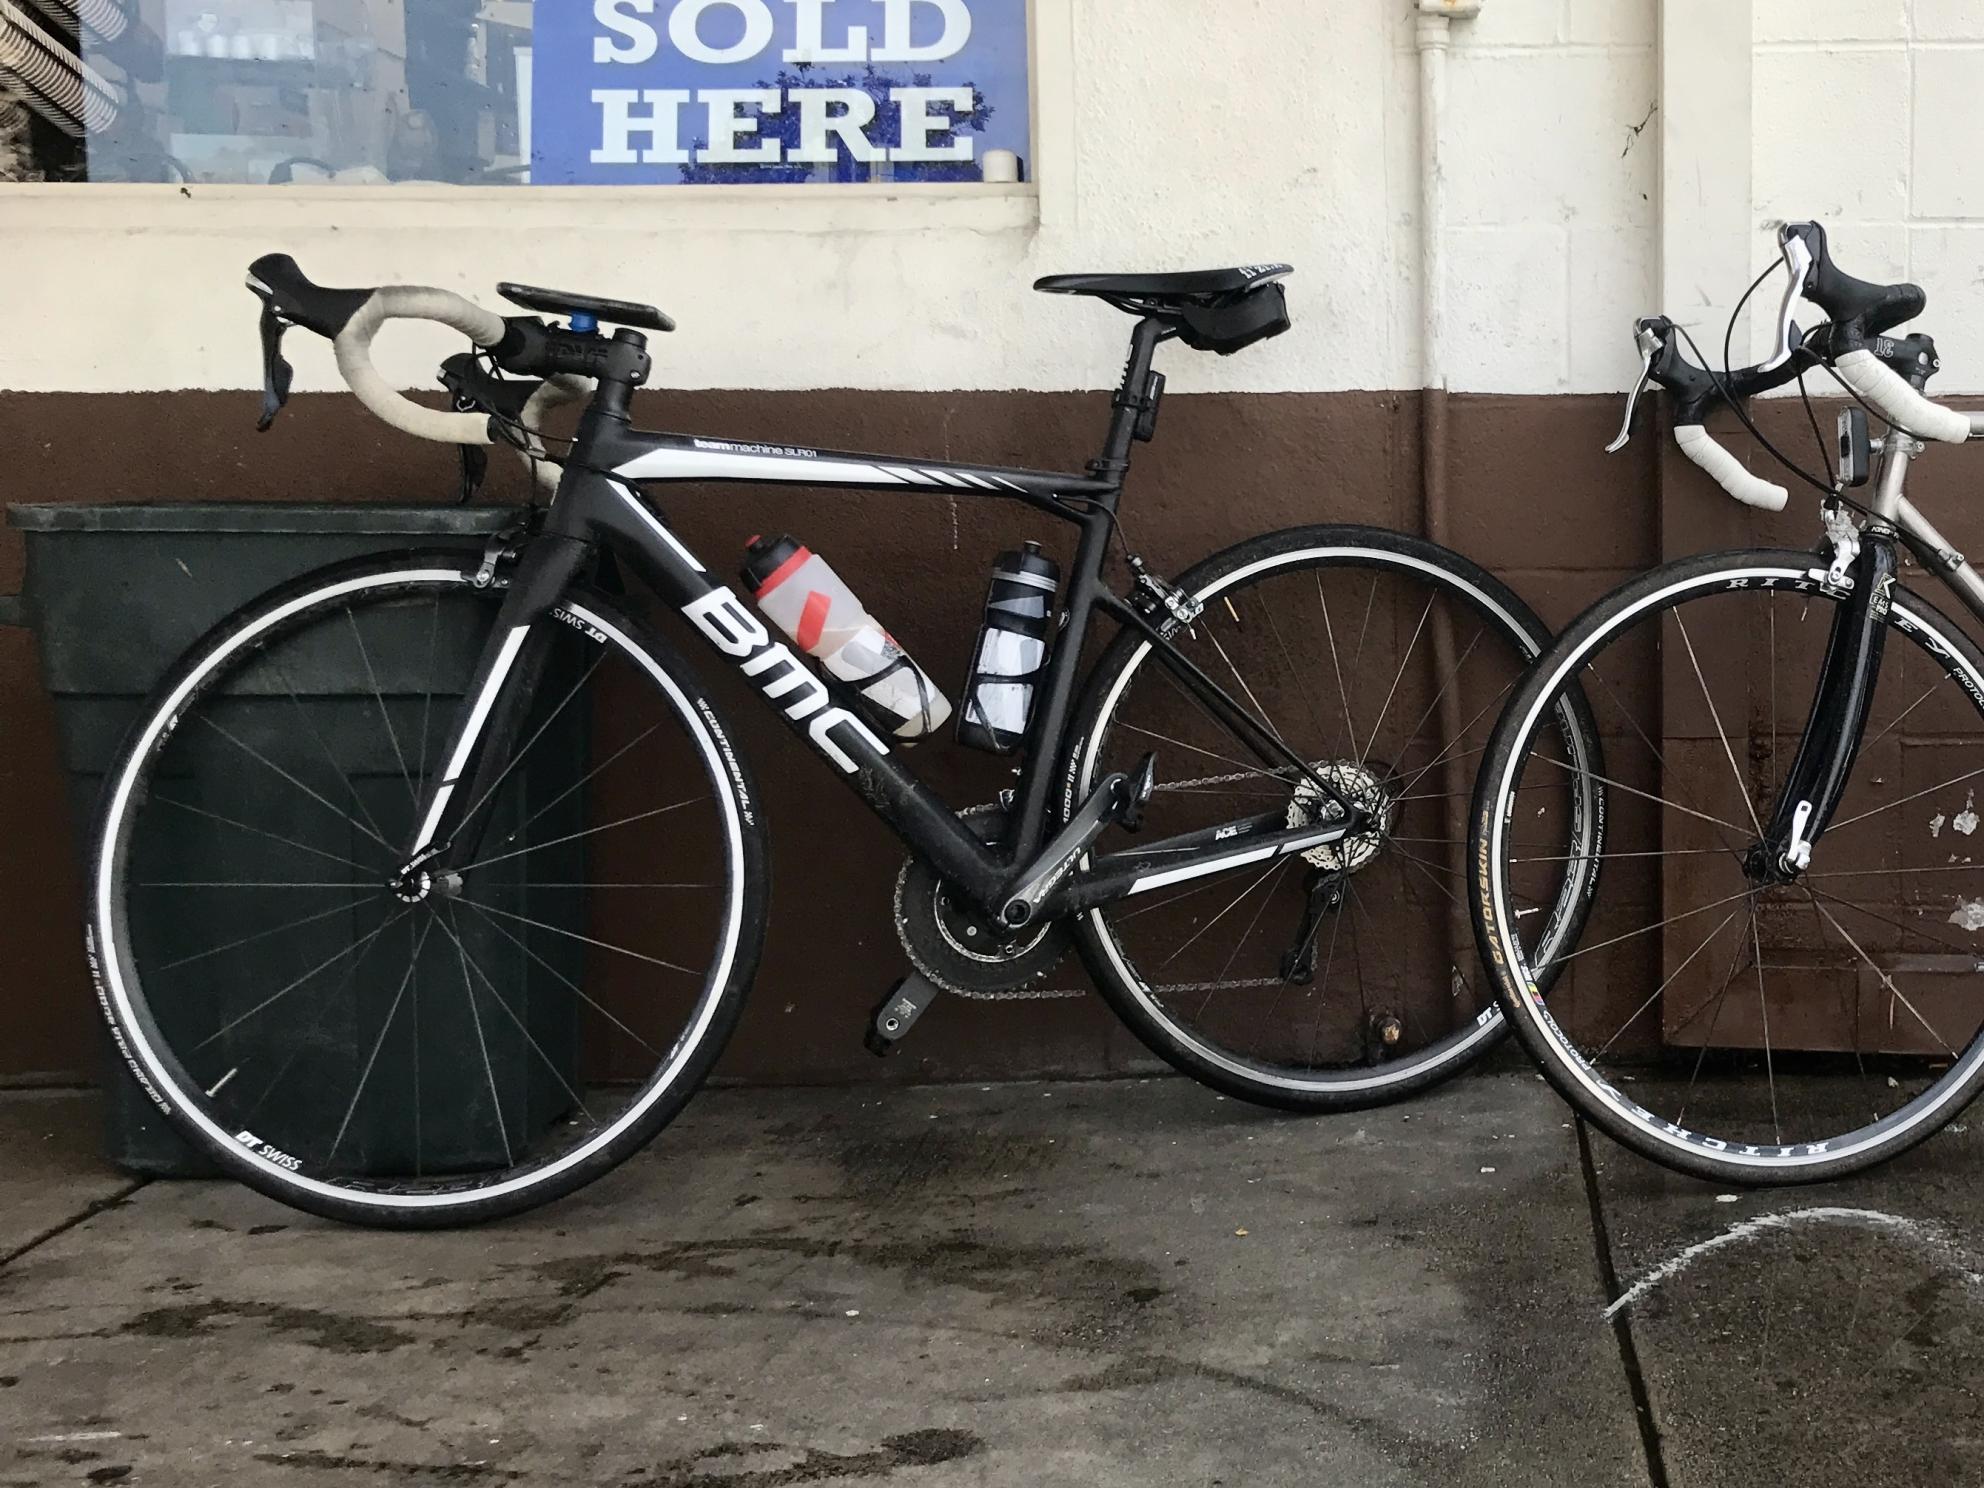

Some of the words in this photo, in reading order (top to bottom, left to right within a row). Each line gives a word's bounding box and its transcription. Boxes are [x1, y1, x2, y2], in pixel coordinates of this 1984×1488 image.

[593, 0, 972, 64] SOLD
[590, 87, 973, 164] HERE
[548, 608, 585, 630] SWIS
[584, 627, 608, 644] DT
[1726, 578, 1951, 659] RITCEY
[680, 586, 890, 773] BMC
[1215, 825, 1238, 841] ACE
[1033, 846, 1081, 904] ULTEGRA
[1478, 838, 1504, 966] GATORSKIN
[1476, 1006, 1493, 1027] DT
[1595, 1079, 1829, 1158] RITCHEY
[235, 1130, 264, 1148] DT
[258, 1144, 303, 1171] SWISS
